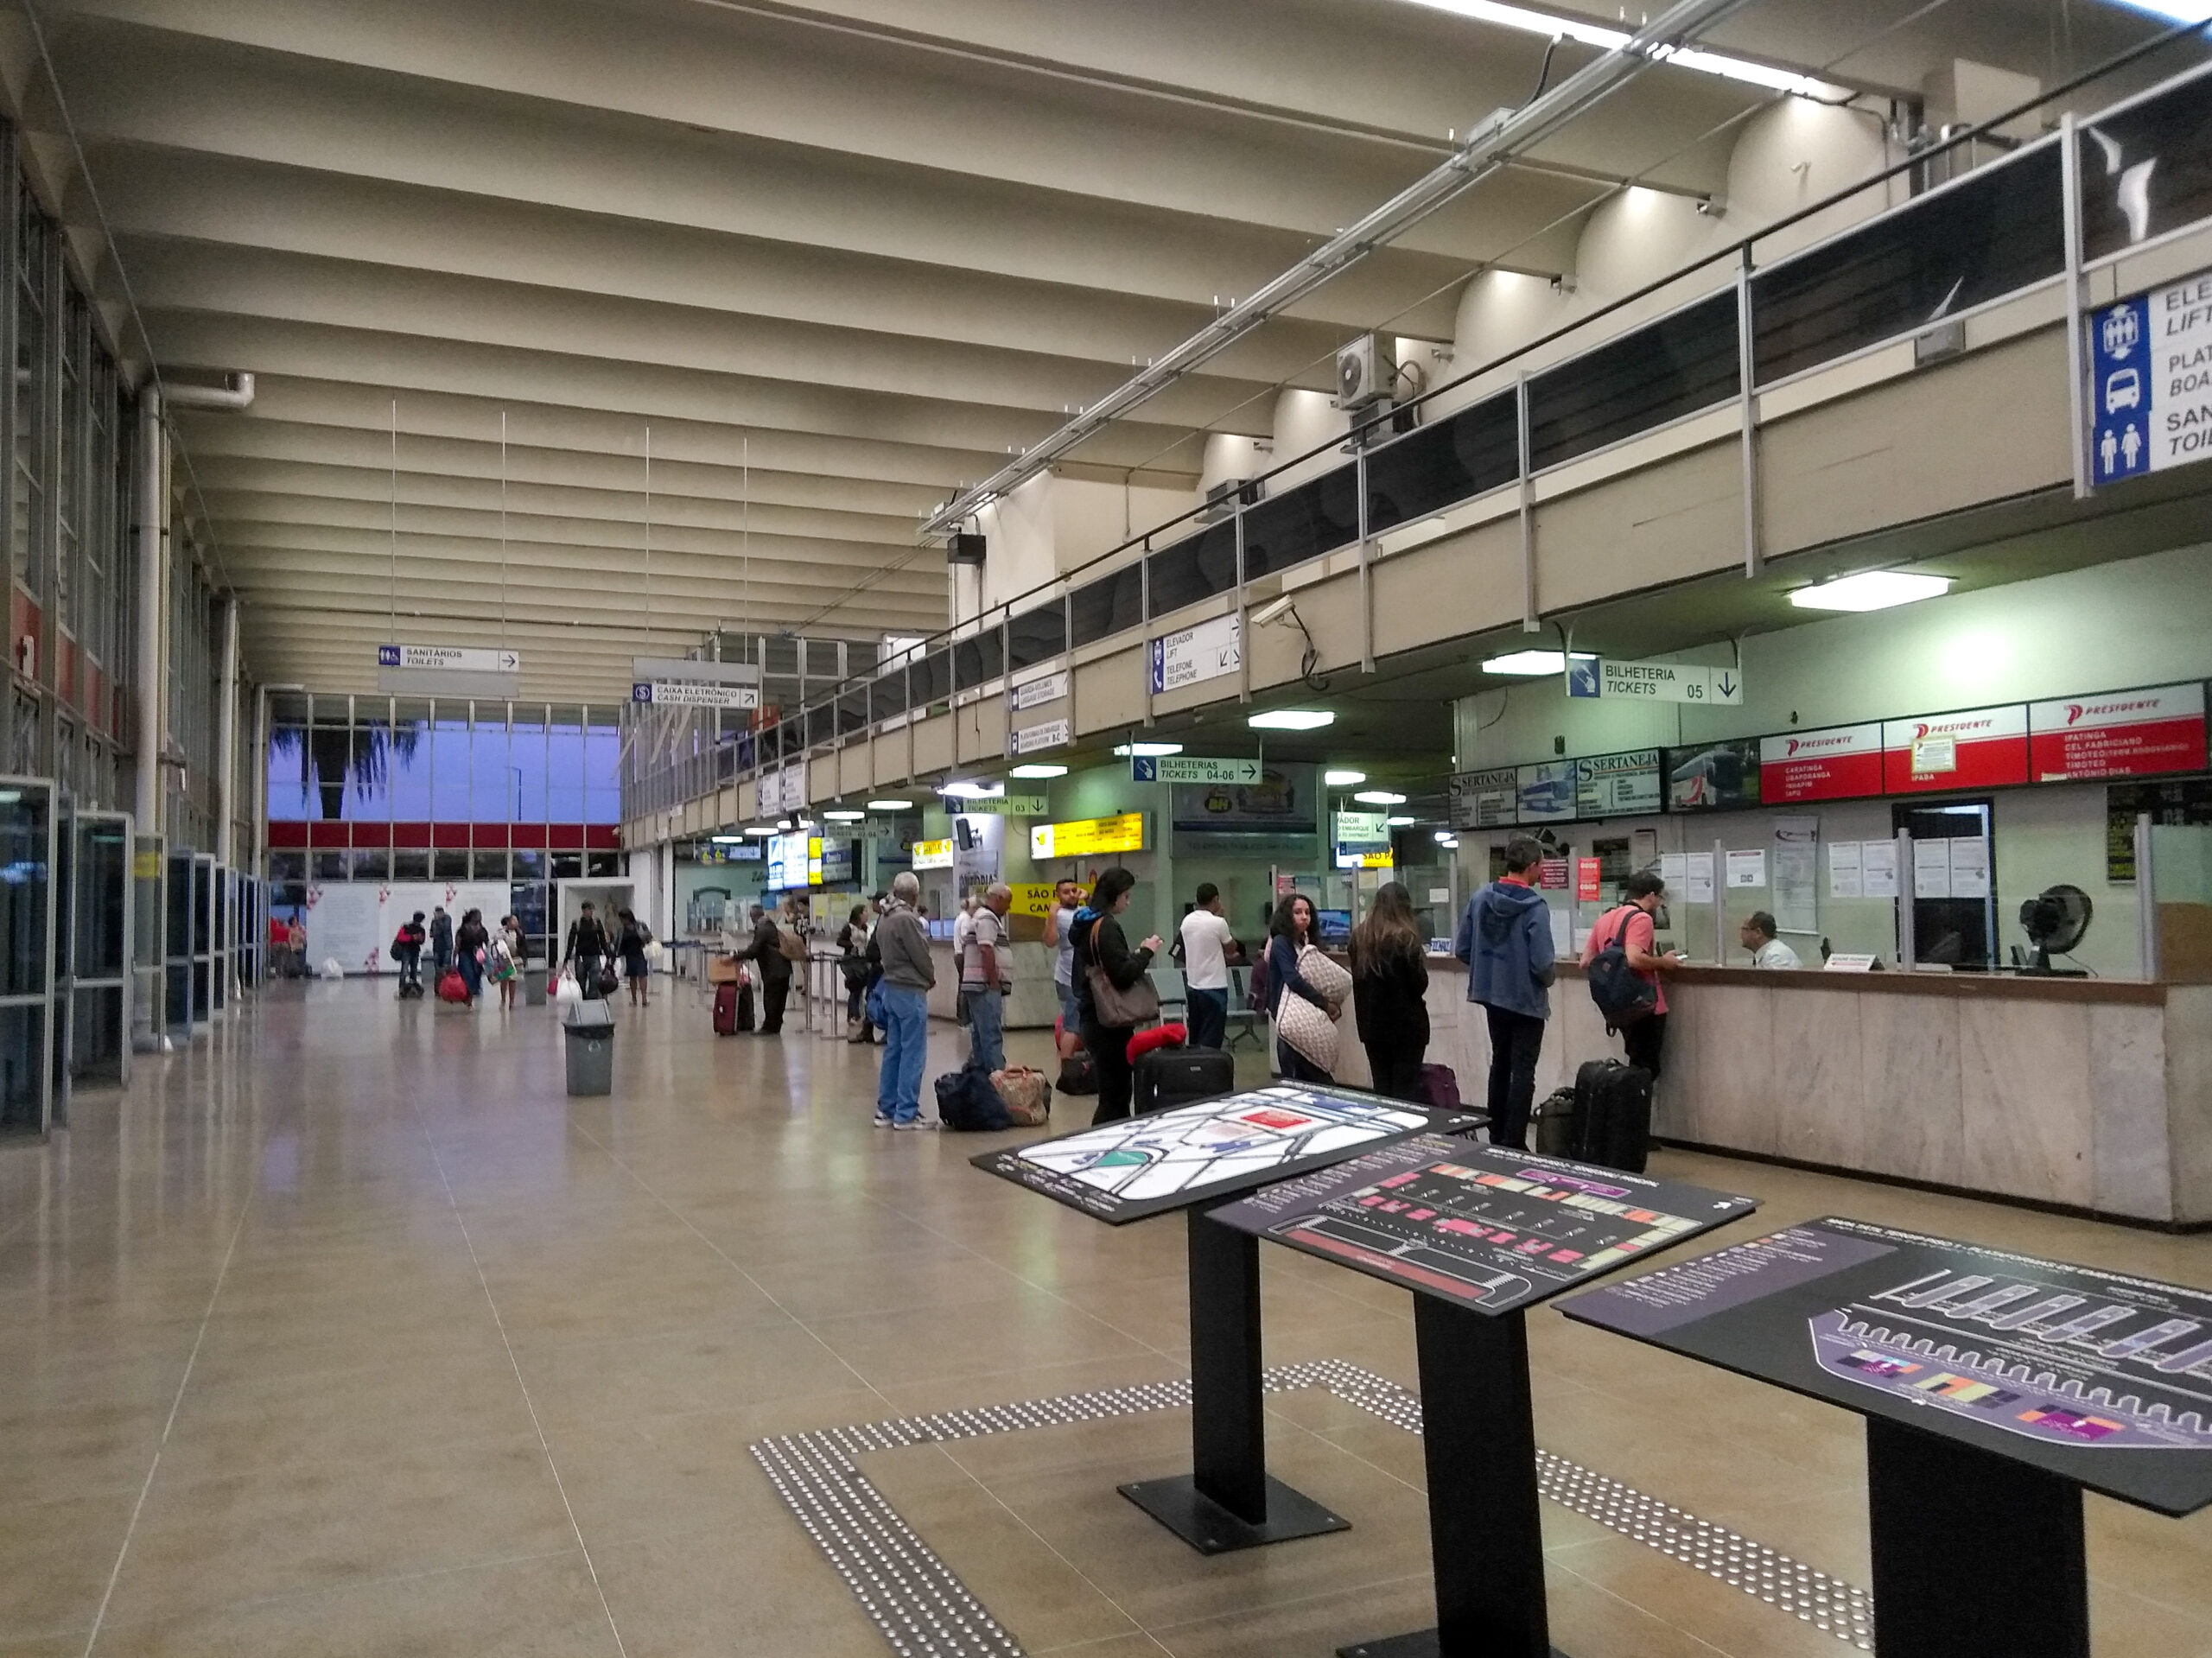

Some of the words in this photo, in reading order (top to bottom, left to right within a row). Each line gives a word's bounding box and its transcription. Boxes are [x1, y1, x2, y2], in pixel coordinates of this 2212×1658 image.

[1166, 632, 1194, 649] ELEVADOR
[407, 647, 462, 658] SANITÁRIOS
[1166, 648, 1178, 659] LIFT
[407, 657, 444, 665] TOILETS
[1166, 660, 1193, 674] TELEFONE
[1166, 669, 1198, 685] TELEPHONE
[1605, 664, 1675, 681] BILHETERIA
[684, 688, 737, 697] ELETRÔNICO
[1607, 681, 1656, 695] TICKETS
[1687, 684, 1703, 698] 05
[657, 694, 681, 702] CASH
[683, 696, 730, 704] DISPENSER
[2085, 699, 2159, 715] PRESIDENTE
[1930, 719, 1993, 733] PRESIDENTE
[1800, 735, 1853, 748] PRESIDENTE
[2064, 731, 2107, 741] IPATINGA
[2085, 737, 2143, 748] FABRICIANO
[1160, 759, 1218, 770] BILHETERIAS
[1593, 753, 1658, 771] SERTANEJA
[2066, 759, 2107, 769] TIMOTEO
[1160, 770, 1198, 778] TICKETS
[1207, 771, 1235, 780] 04-06
[1785, 765, 1823, 774] CARATINGA
[1462, 772, 1515, 787] SERTANEJA
[1027, 886, 1049, 899] SÃO
